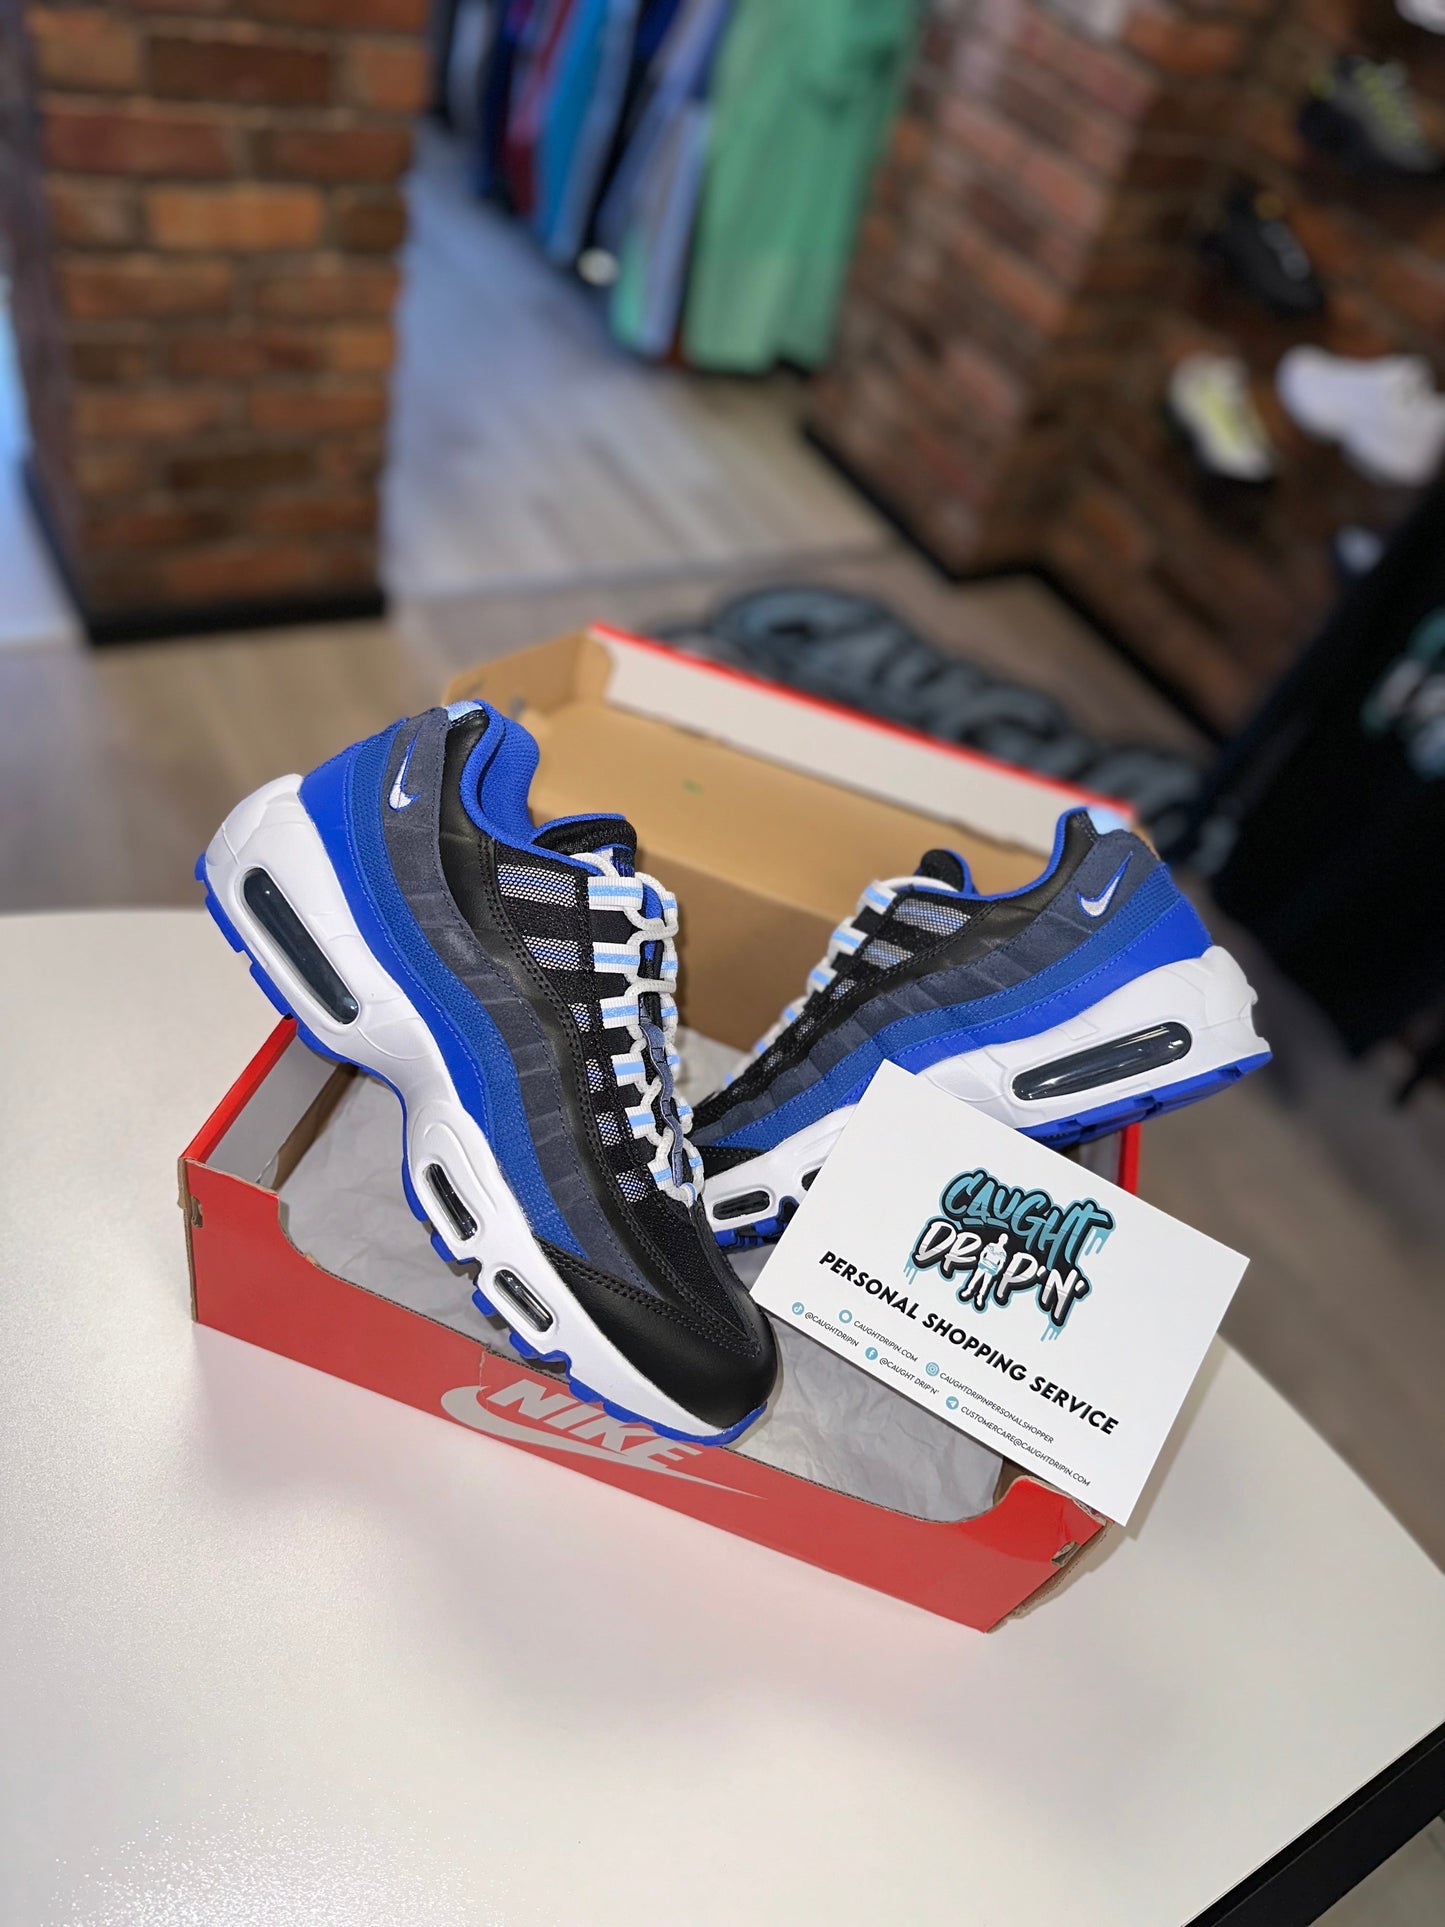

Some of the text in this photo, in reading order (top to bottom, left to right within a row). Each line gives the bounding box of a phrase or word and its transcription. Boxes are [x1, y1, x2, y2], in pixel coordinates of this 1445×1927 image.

[943, 1171, 1110, 1272] CAUGHT
[804, 1311, 860, 1347] @CAUGHTDRIPIN
[819, 1250, 1120, 1435] PERSONAL SHOPPING SERVICE
[853, 1320, 919, 1362] CAUGHTDRIPIN.COM
[879, 1357, 915, 1381] @CAUGHT
[485, 1378, 704, 1470] NIKE
[939, 1372, 1055, 1444] CAUGHTDRIPINPERSONALSHOPPER
[960, 1406, 1092, 1487] CUSTOMERCARE@CAUGHTDRIPIN.COM
